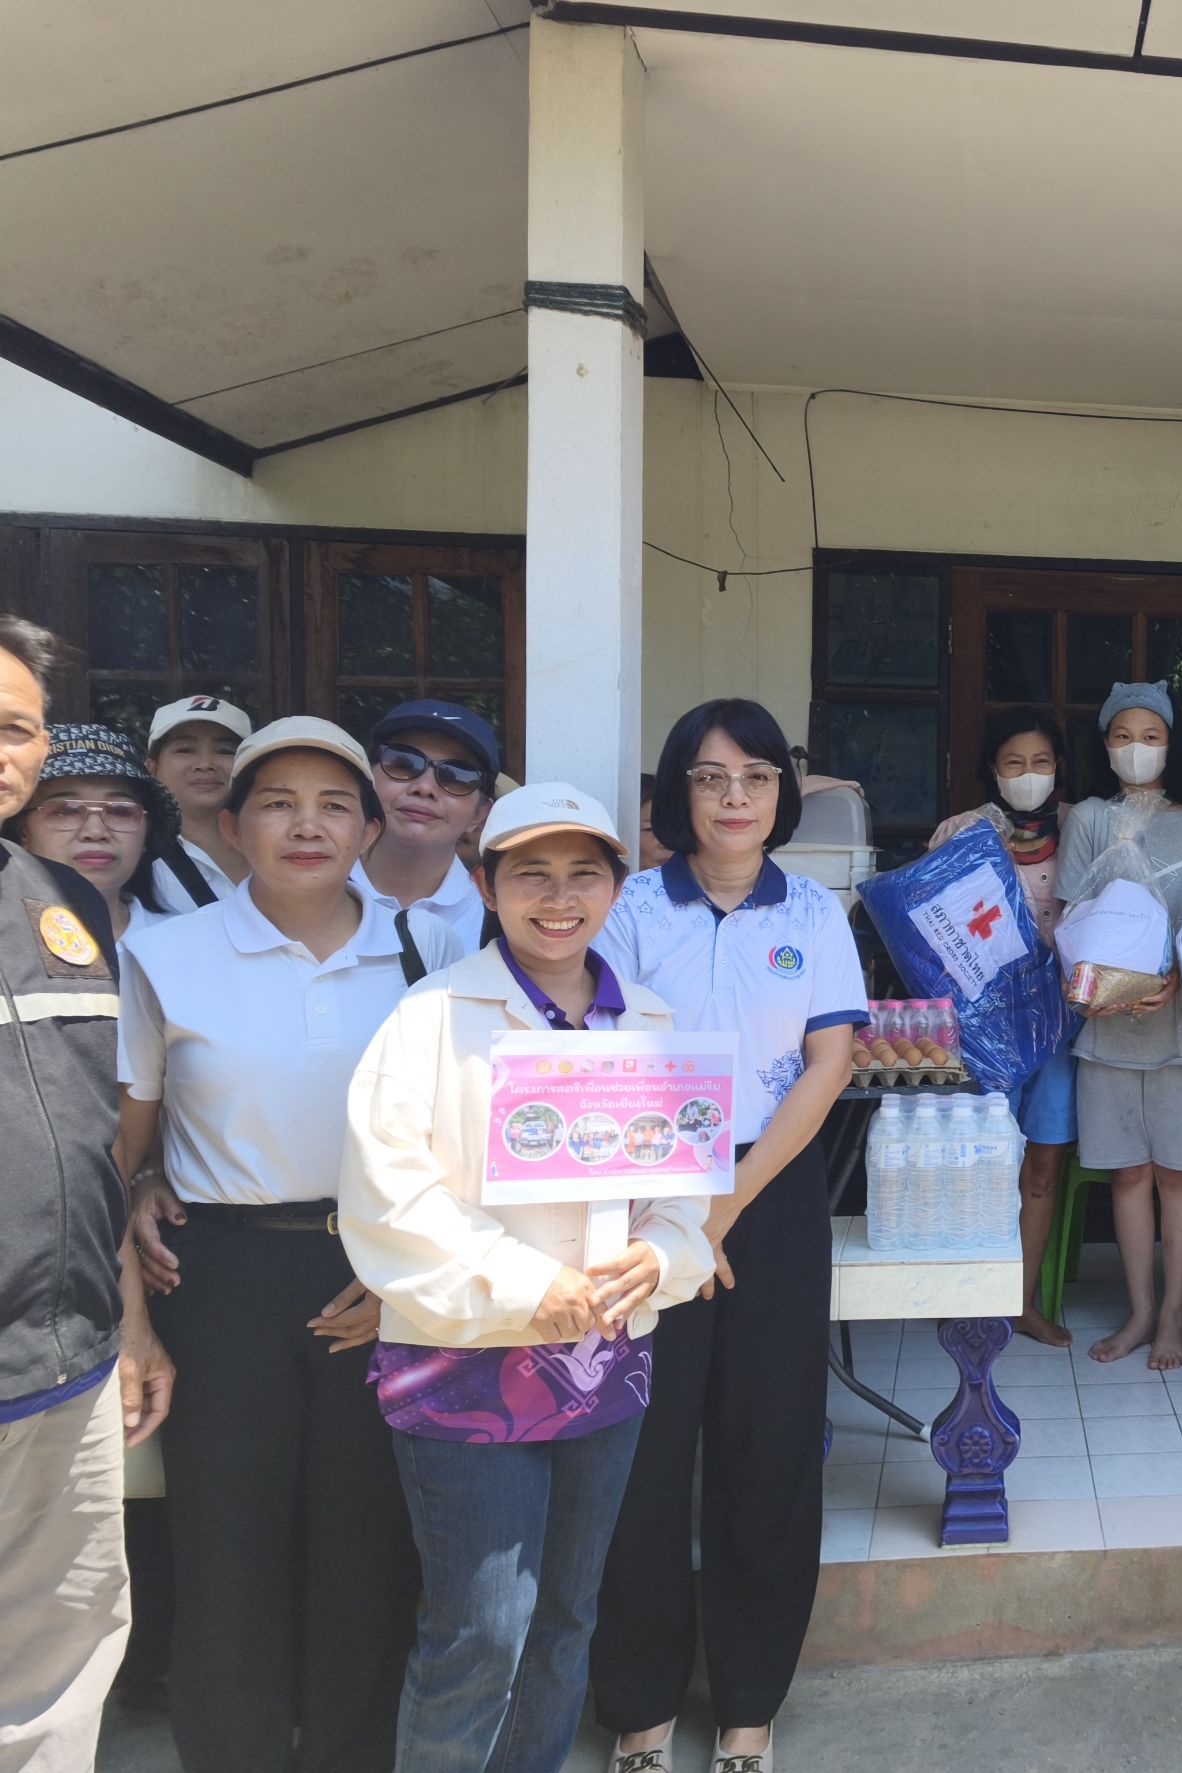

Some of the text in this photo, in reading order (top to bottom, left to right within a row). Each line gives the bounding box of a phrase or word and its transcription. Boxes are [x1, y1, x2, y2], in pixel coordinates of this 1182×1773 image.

[922, 912, 978, 987] THAI RED CROSS SOCIETY
[930, 903, 985, 982] สภากาชาดไทย
